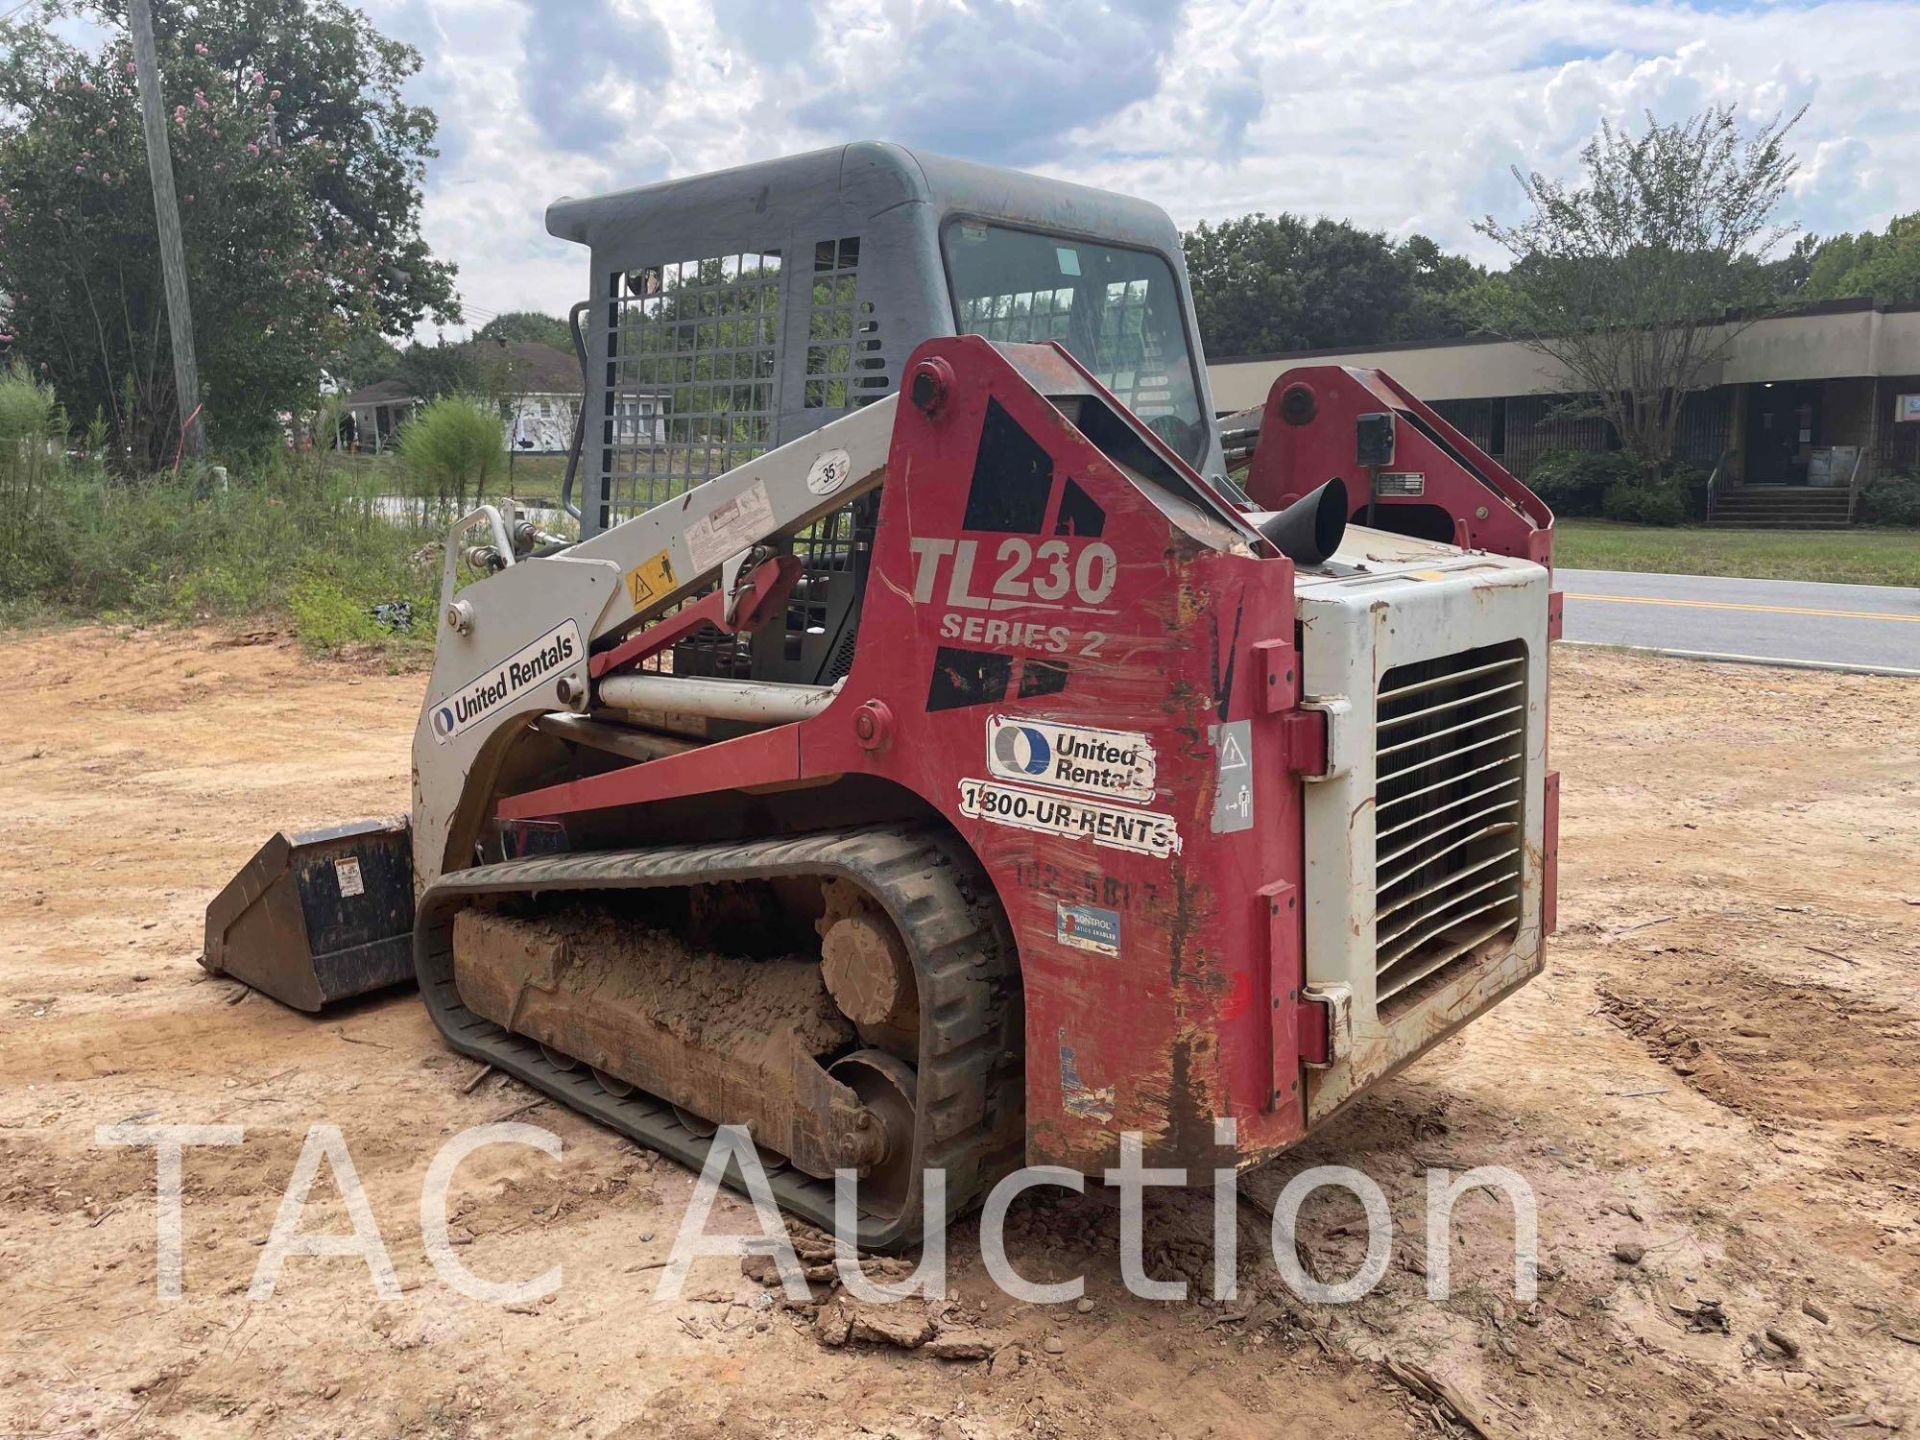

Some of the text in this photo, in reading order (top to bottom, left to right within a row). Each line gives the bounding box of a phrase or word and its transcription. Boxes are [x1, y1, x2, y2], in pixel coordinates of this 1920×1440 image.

[909, 537, 1118, 610] TL230
[940, 613, 1106, 657] SERIES 2
[454, 635, 573, 723] United Rentals
[1055, 733, 1137, 767] United
